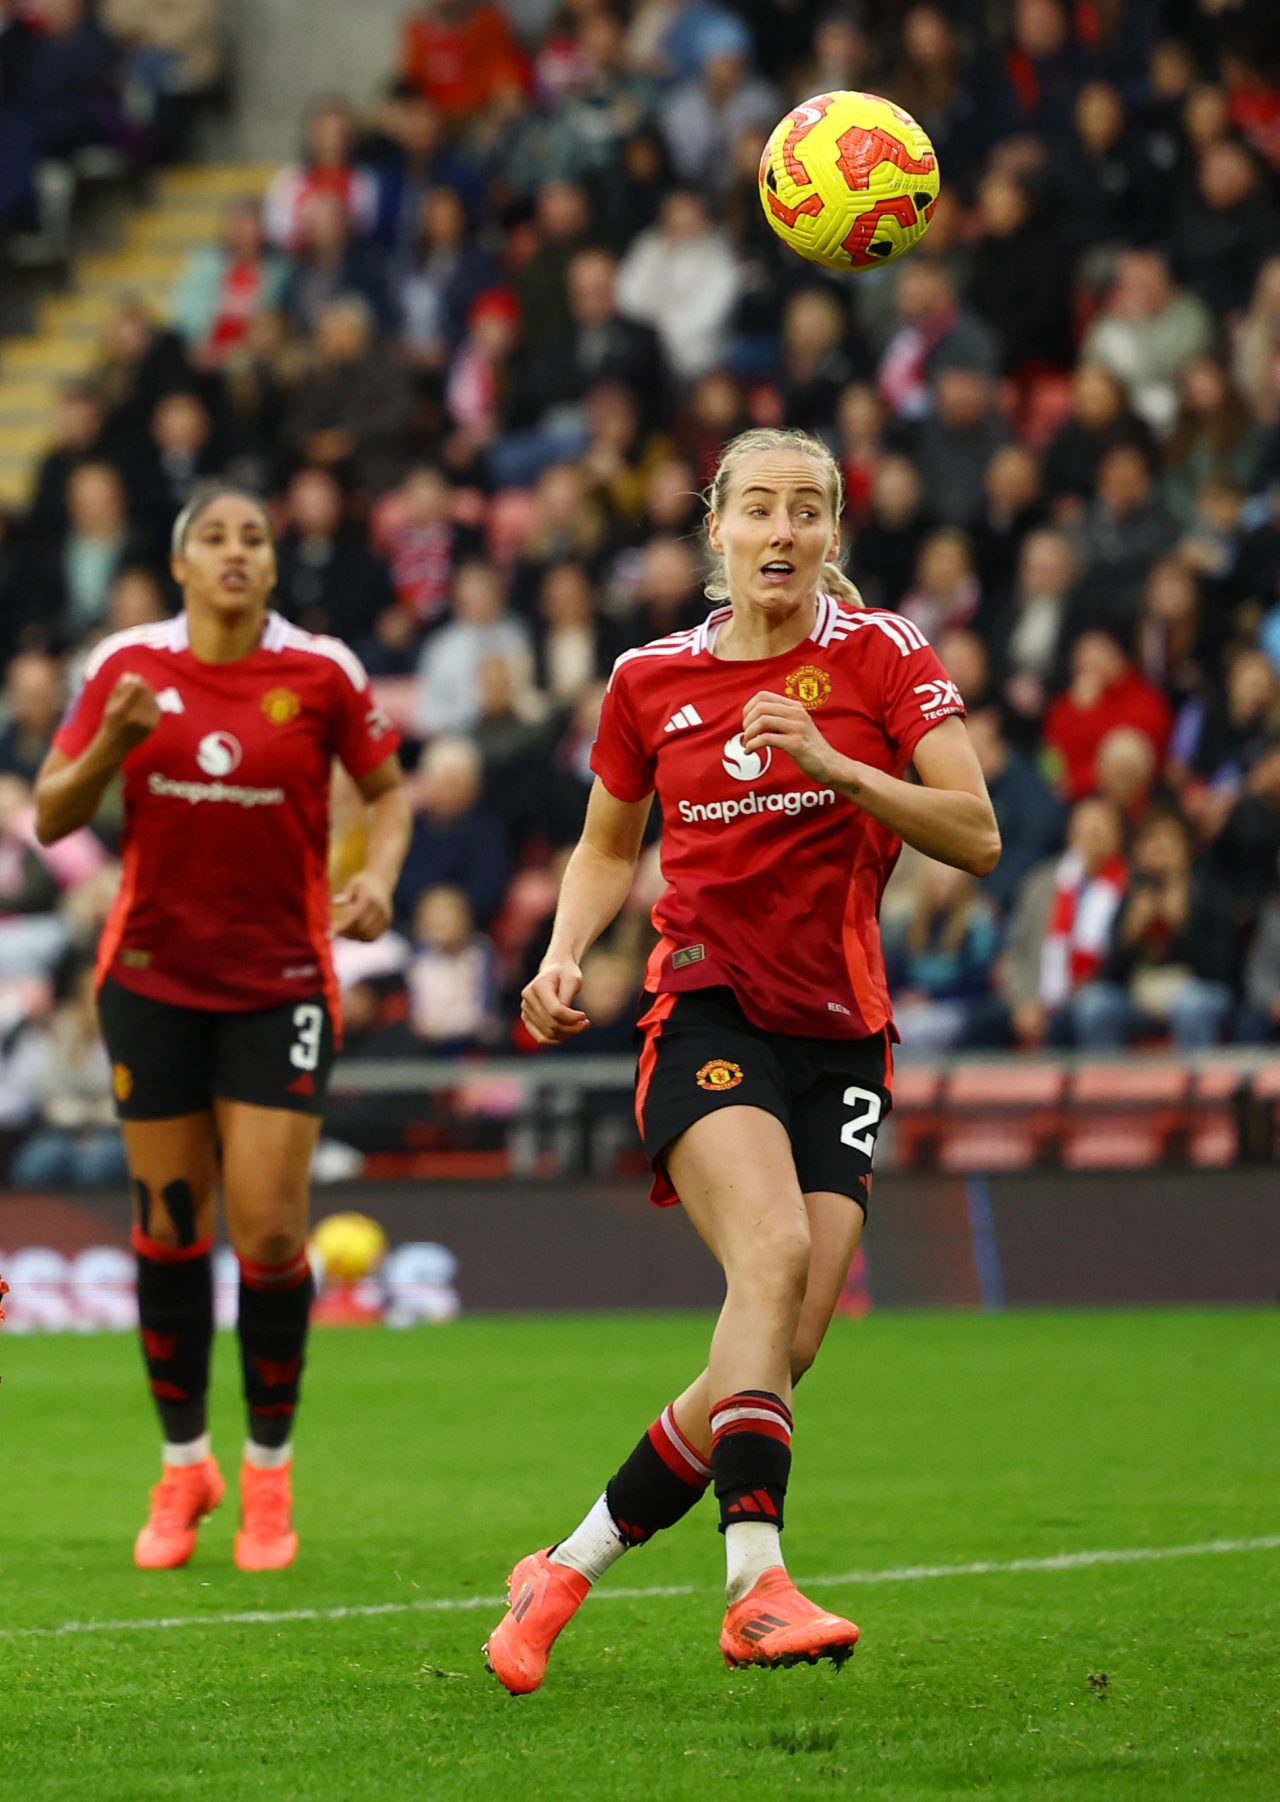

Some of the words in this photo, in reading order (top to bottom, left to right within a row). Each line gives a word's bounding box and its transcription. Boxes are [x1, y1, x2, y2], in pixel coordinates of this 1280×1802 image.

[678, 789, 836, 823] Snapdragon
[289, 1003, 323, 1071] 3
[841, 1086, 881, 1158] 2
